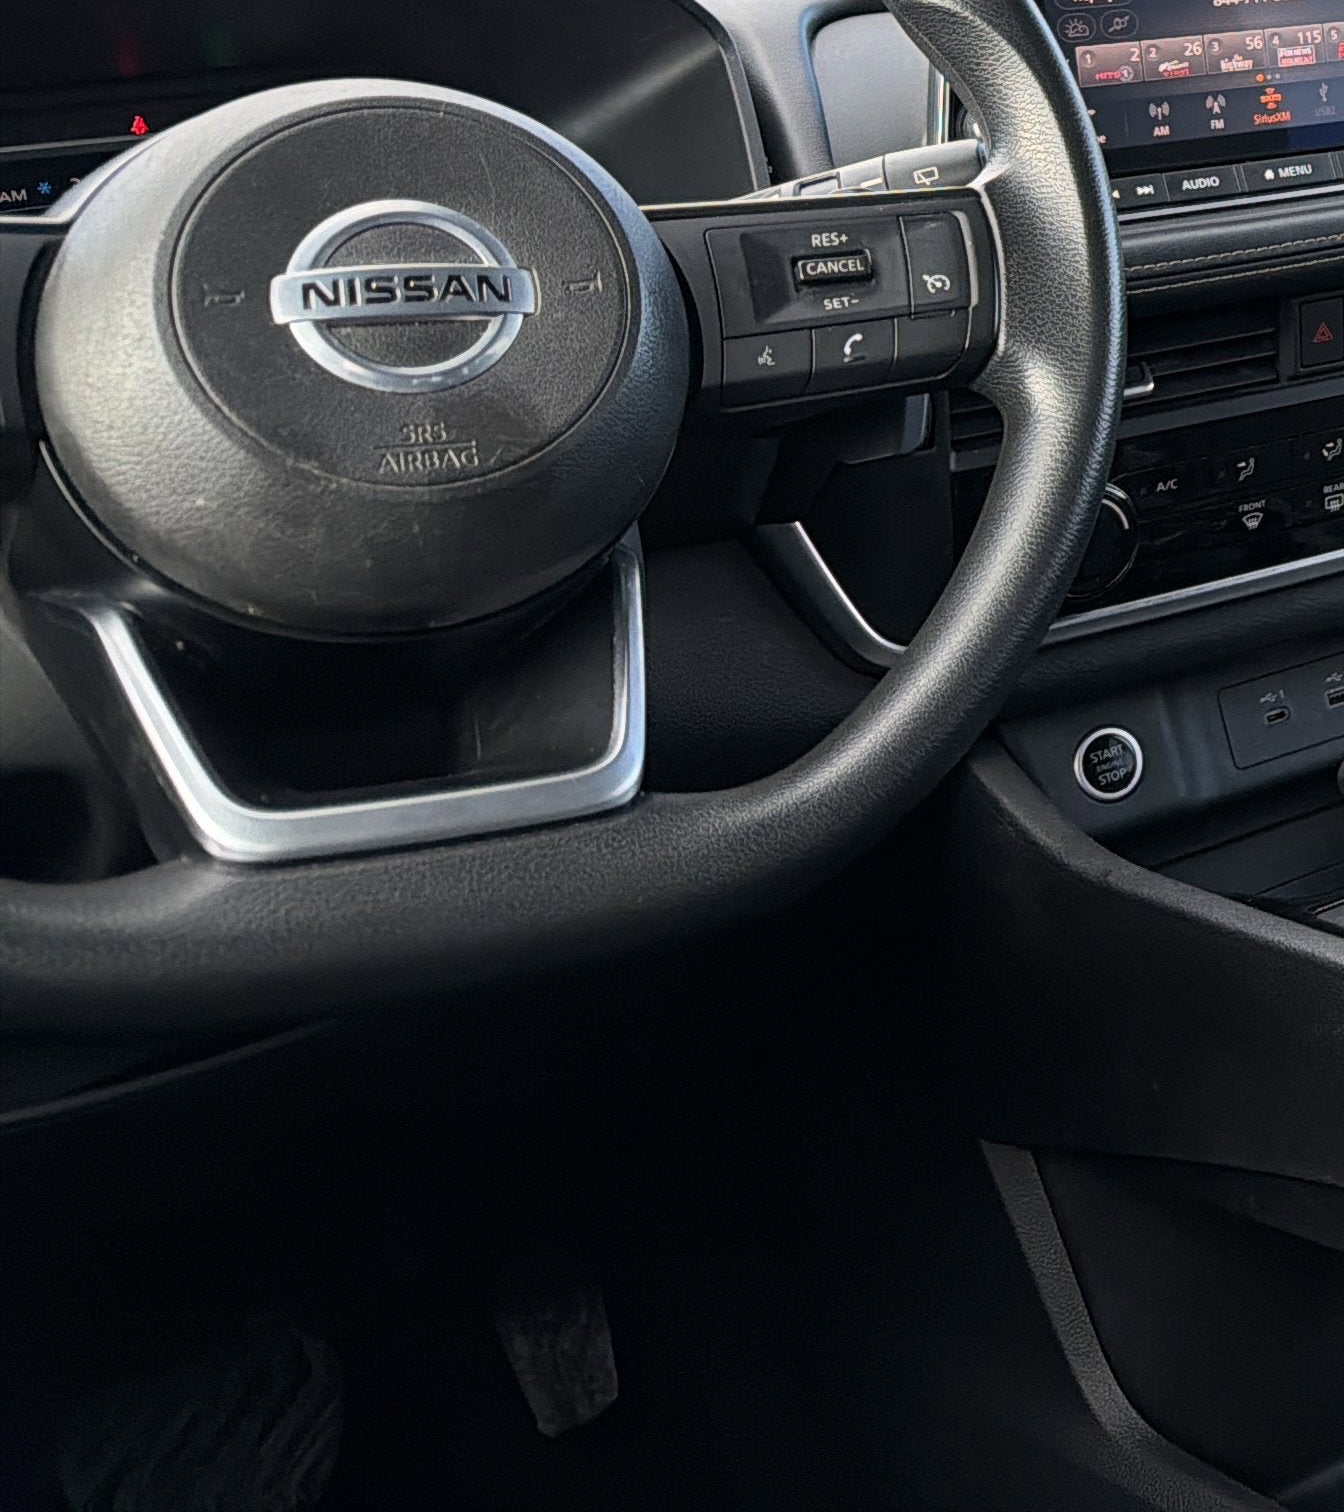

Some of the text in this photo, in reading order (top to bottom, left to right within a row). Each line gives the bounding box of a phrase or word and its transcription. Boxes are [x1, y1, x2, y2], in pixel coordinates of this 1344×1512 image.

[1272, 35, 1280, 46] 4
[1297, 30, 1322, 44] 115
[1330, 30, 1338, 40] 5
[1183, 41, 1203, 57] 26
[1211, 41, 1219, 52] 3
[1245, 36, 1265, 51] 56
[1084, 53, 1092, 65] 1
[1129, 47, 1141, 62] 2
[1149, 47, 1158, 58] 2
[1253, 110, 1291, 125] SiriusXM
[1315, 105, 1336, 117] USB2
[1153, 125, 1170, 137] AM
[1210, 119, 1225, 130] FM
[1278, 164, 1313, 179] MENU
[1182, 176, 1220, 191] AUDIO
[811, 231, 849, 248] RES+
[806, 259, 865, 276] CANCEL
[301, 273, 513, 311] NISSAN
[823, 296, 860, 311] SET-
[401, 422, 447, 444] SRS
[379, 446, 479, 474] AIRBAG
[1156, 478, 1179, 493] A/C
[1323, 482, 1344, 494] REAR
[1238, 499, 1267, 513] FRONT
[1090, 743, 1123, 764] START
[1098, 767, 1127, 786] STOP
